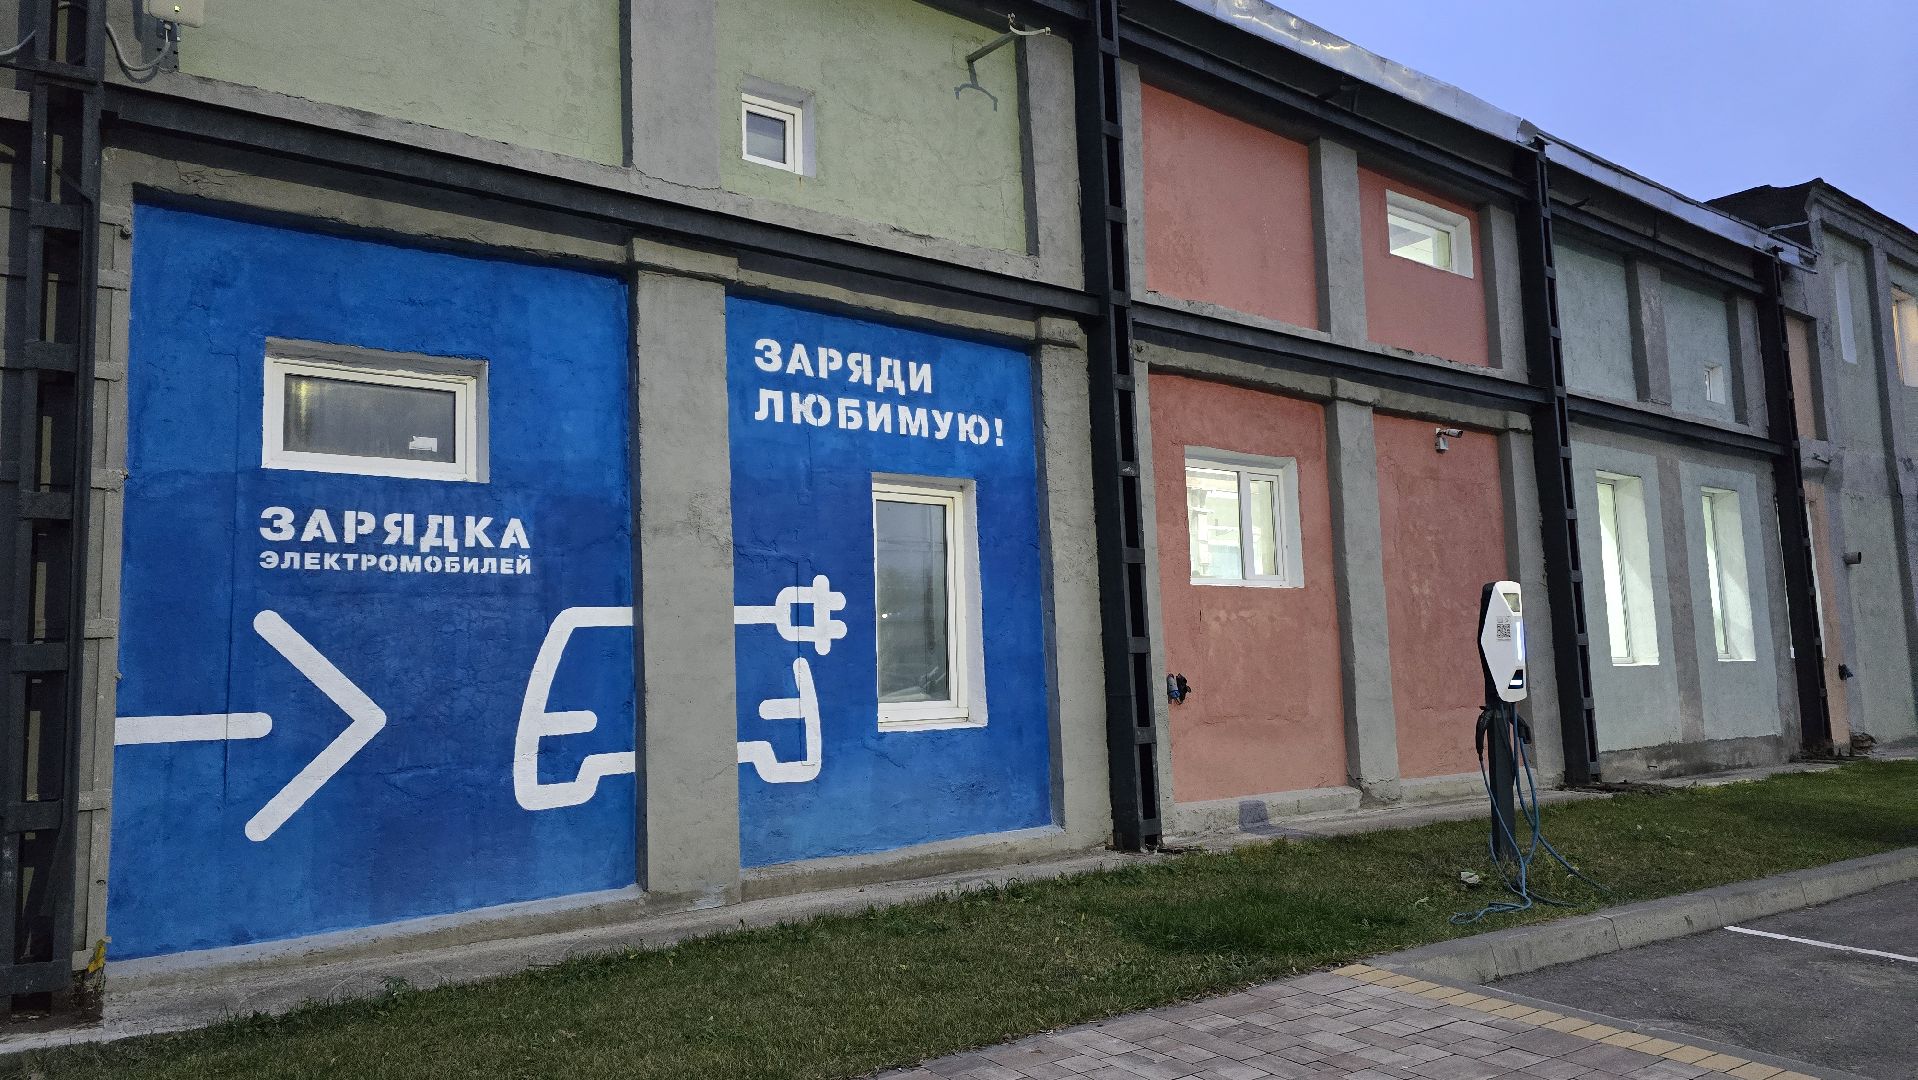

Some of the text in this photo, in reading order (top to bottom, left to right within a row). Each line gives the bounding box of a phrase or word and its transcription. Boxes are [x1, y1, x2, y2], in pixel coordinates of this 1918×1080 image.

[754, 338, 932, 396] ЗАРЯДИ
[754, 388, 1004, 447] ЛЮБИМУЮ!
[259, 506, 531, 553] ЗАРЯДКА
[259, 551, 531, 575] ЭЛЕКТРОМОБИЛЕЙ
